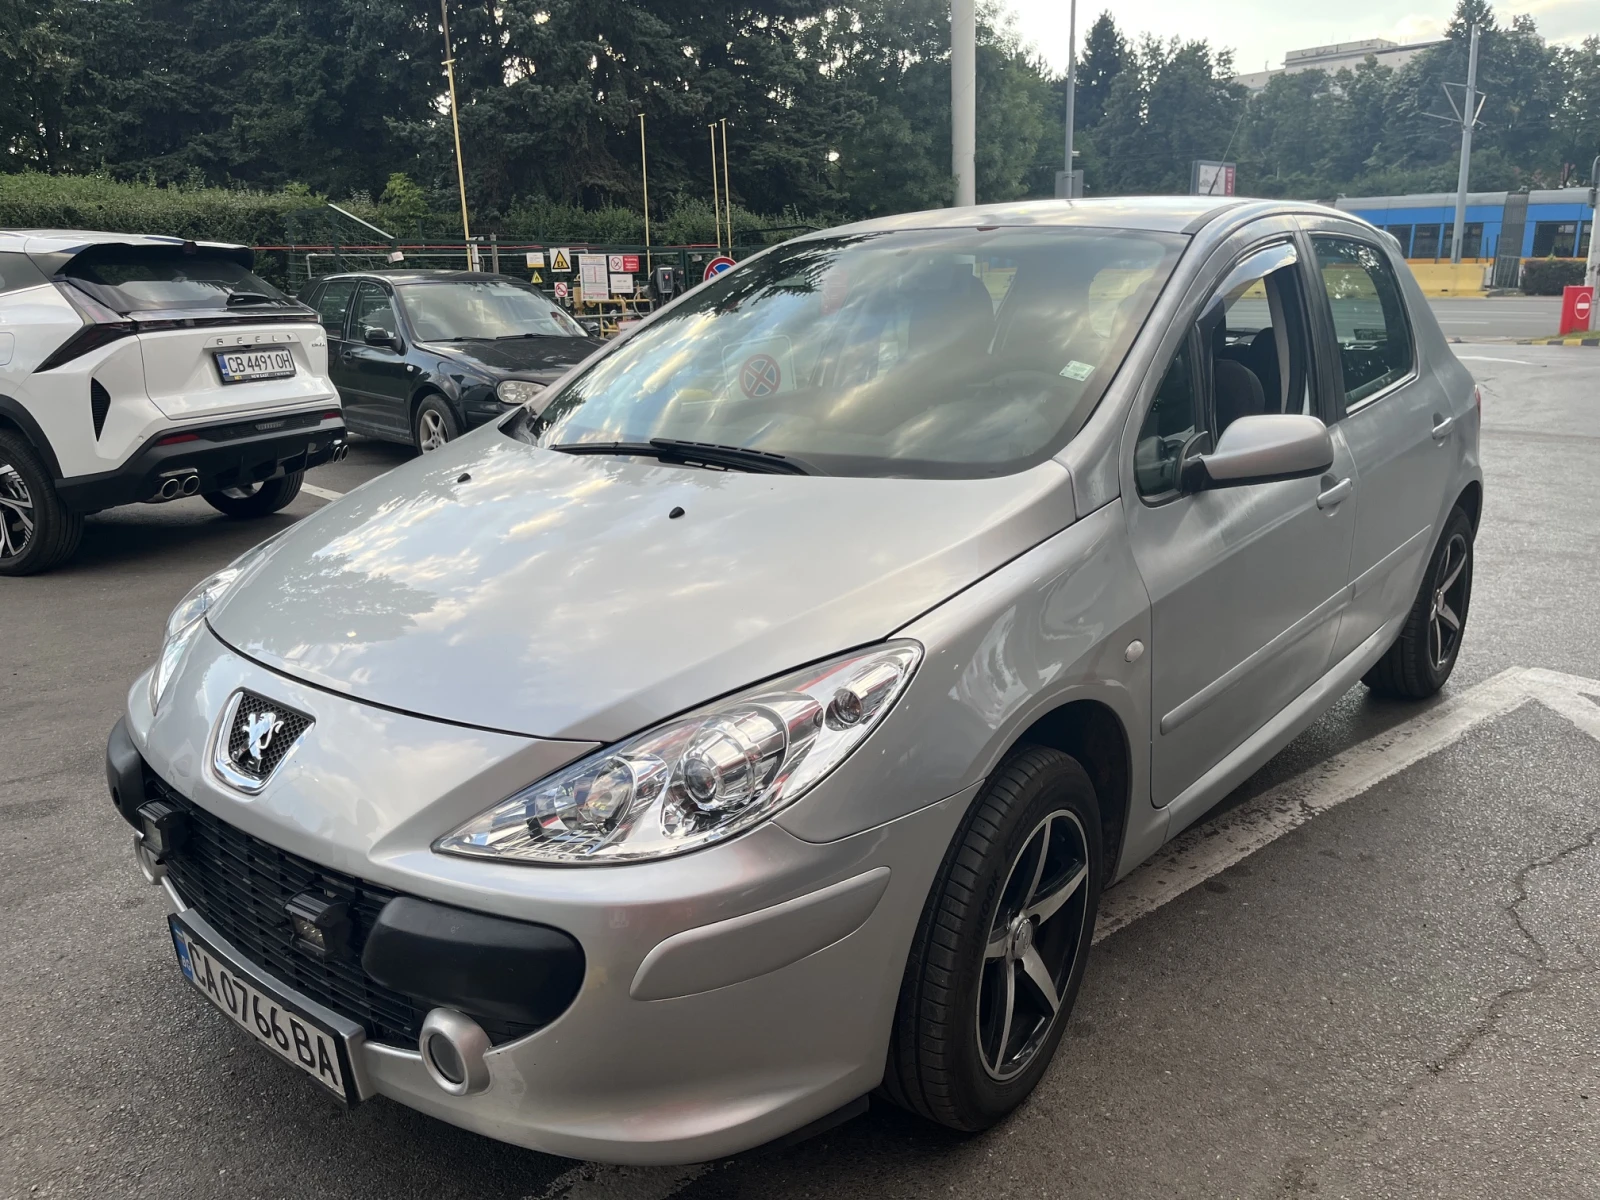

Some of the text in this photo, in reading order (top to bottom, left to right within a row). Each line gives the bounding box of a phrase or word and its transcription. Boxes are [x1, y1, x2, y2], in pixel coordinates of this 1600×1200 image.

[217, 334, 292, 345] GEELY
[227, 356, 246, 373] CB
[247, 354, 275, 371] 4491
[181, 954, 192, 971] BG
[188, 941, 339, 1087] CA 0766 BA
